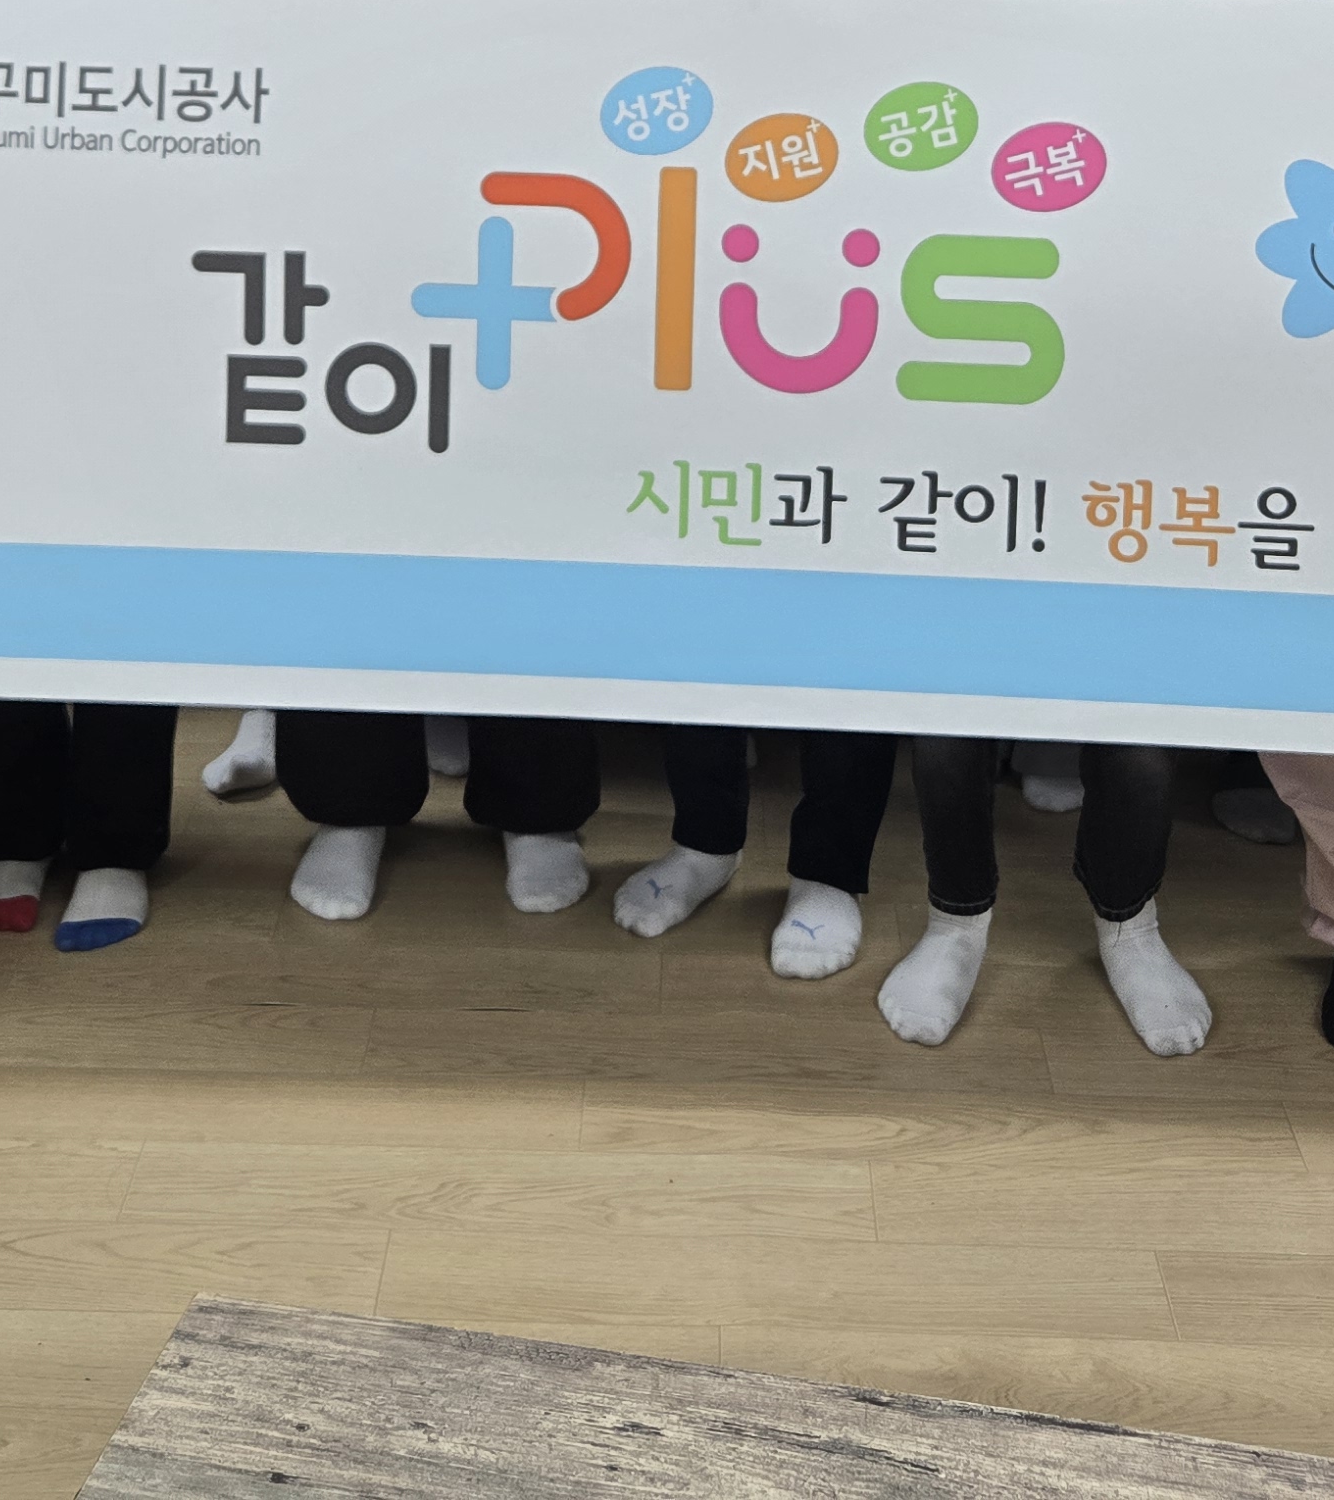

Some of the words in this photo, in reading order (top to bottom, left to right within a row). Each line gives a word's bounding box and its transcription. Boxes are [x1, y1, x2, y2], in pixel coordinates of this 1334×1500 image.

[43, 127, 113, 152] Urban
[120, 128, 261, 159] Corporation
[610, 83, 689, 143] 성장
[877, 96, 959, 153] 공감
[737, 131, 822, 187] 지원
[1004, 139, 1087, 199] 극복
[191, 249, 451, 455] 같이
[625, 458, 848, 548] 시민과
[878, 469, 1049, 555] 같이!
[1082, 477, 1315, 572] 행복을
